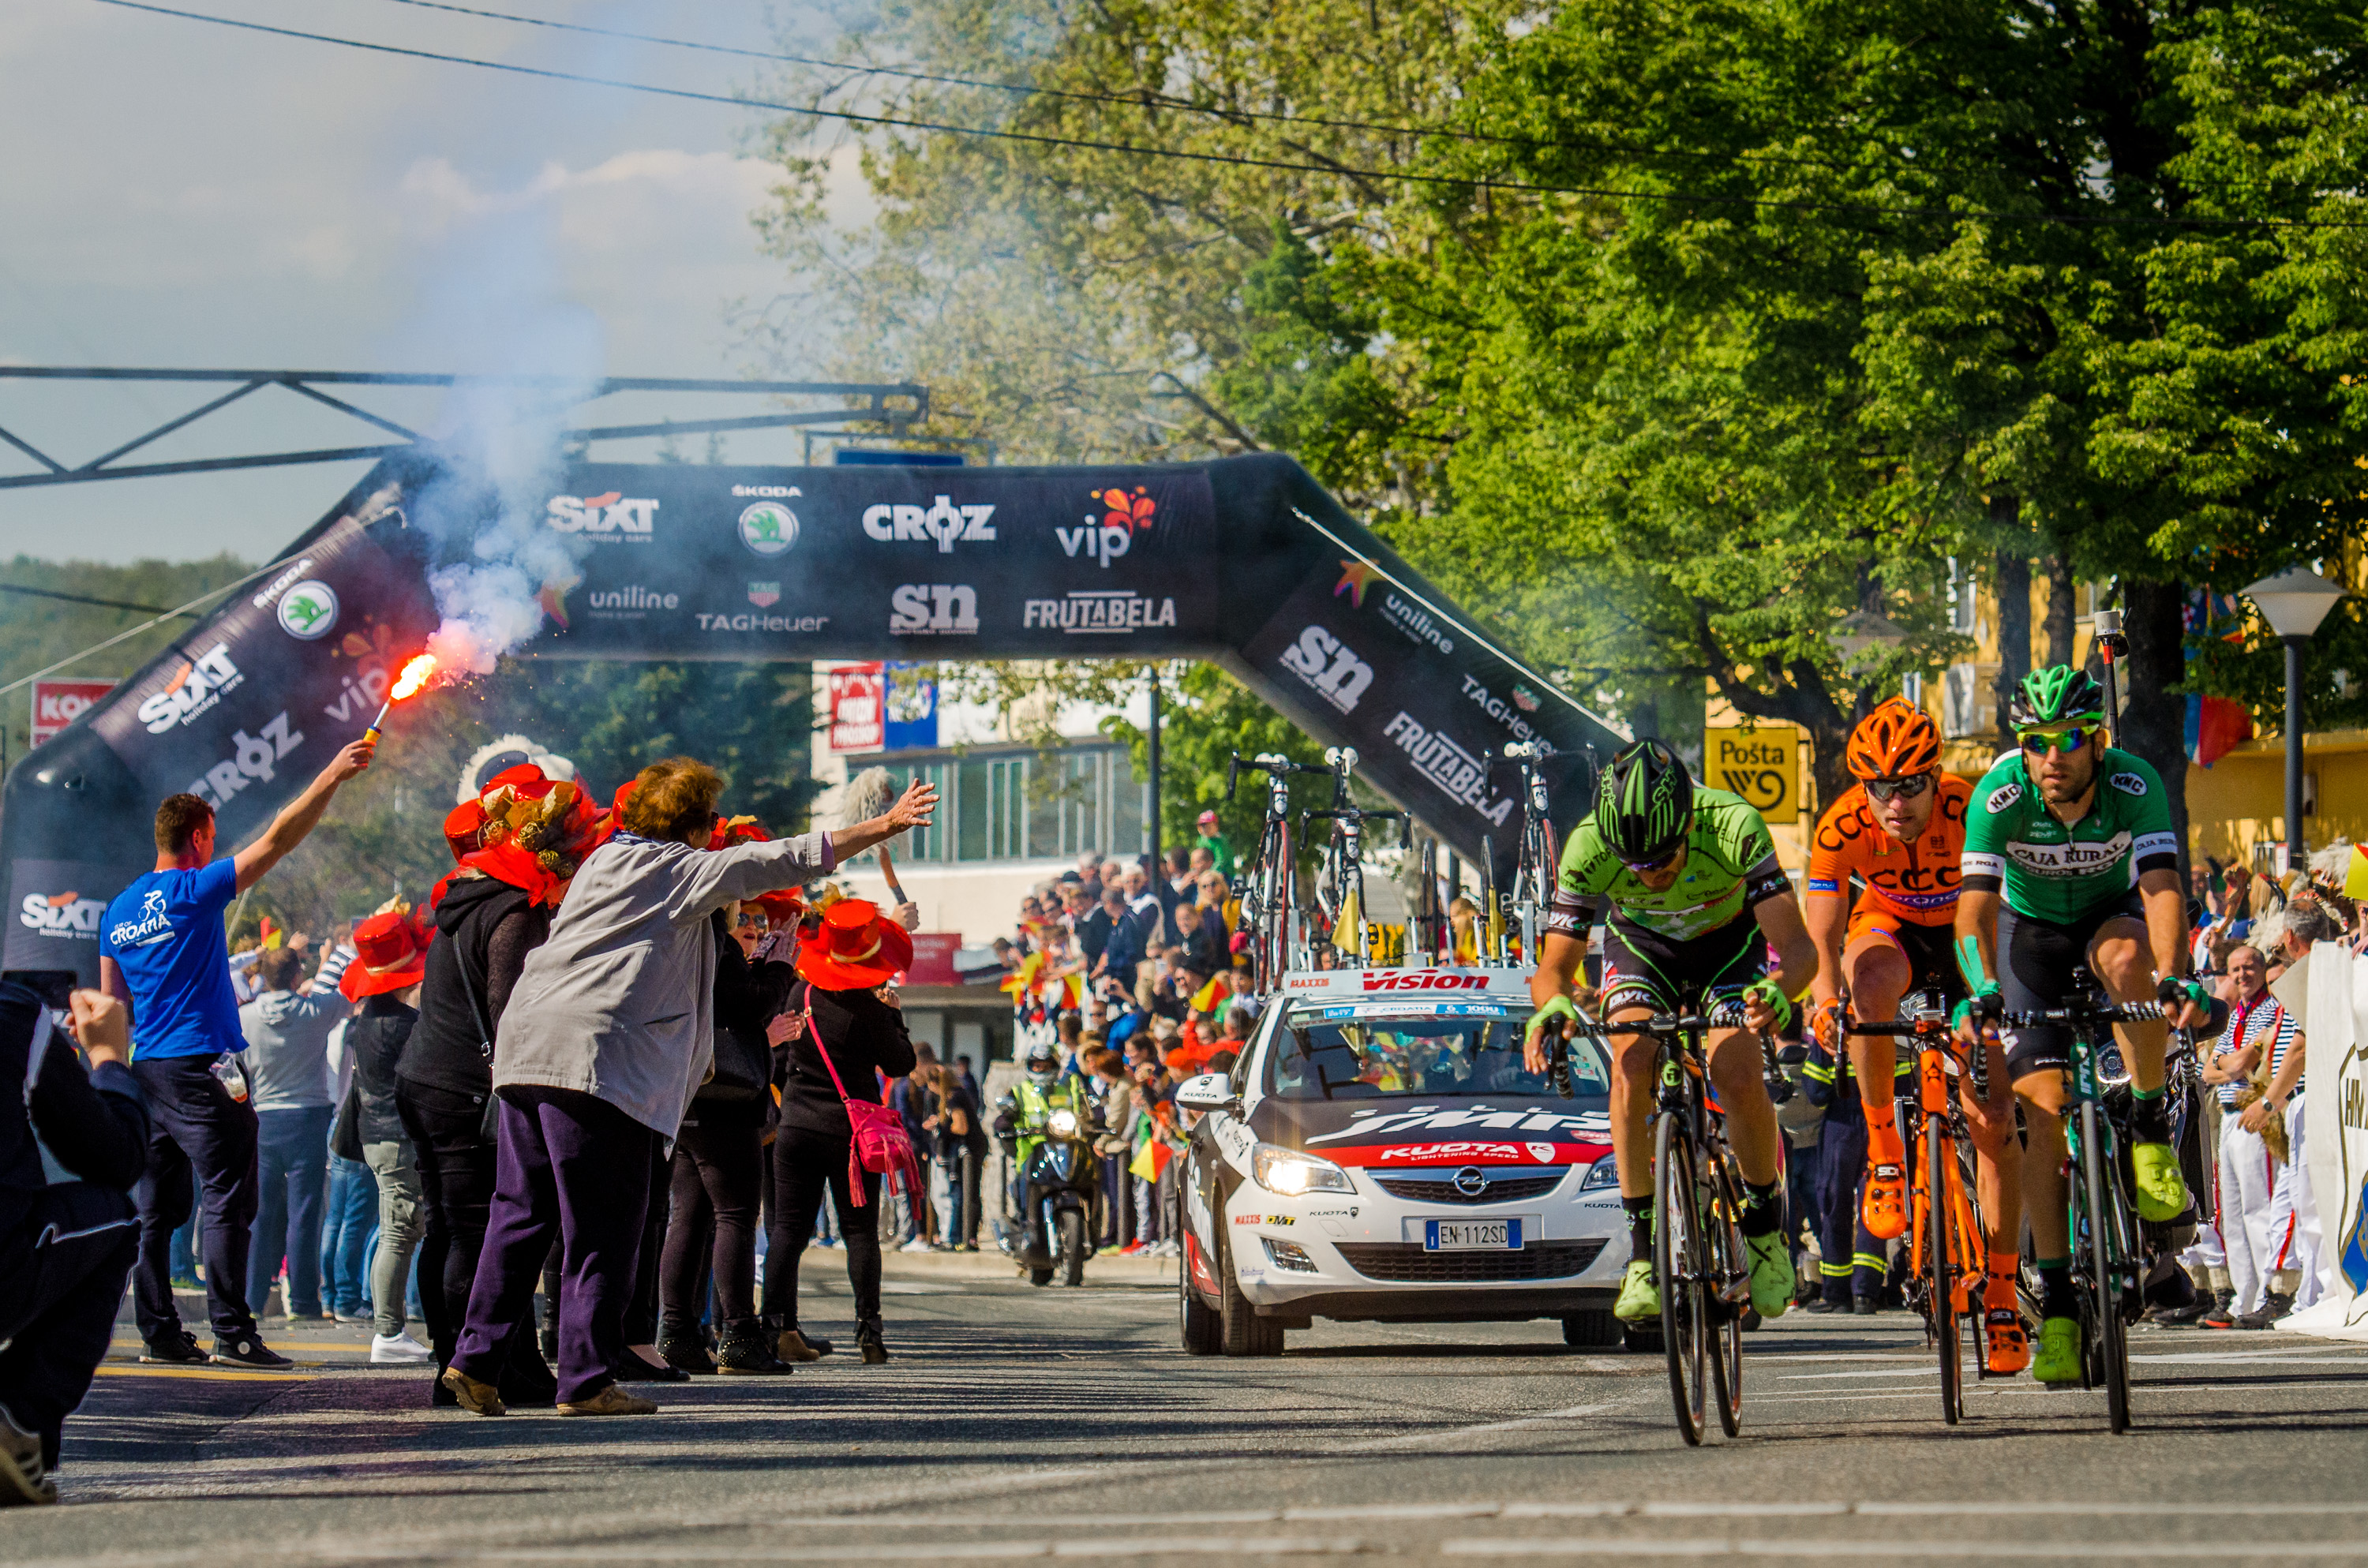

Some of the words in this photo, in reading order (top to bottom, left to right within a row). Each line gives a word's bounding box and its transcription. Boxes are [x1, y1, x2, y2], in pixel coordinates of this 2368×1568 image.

[731, 483, 804, 498] ŠKODA
[546, 491, 660, 533] SIXT
[861, 495, 997, 554] CROZ
[1055, 514, 1132, 569] vip
[589, 585, 680, 610] uniline
[889, 583, 979, 630] sn
[1022, 597, 1178, 629] FRUTABELA
[1385, 592, 1455, 655] uniline
[1281, 623, 1375, 713] sn
[137, 642, 238, 735] SIXT
[180, 690, 221, 727] holiday
[219, 672, 246, 695] cars
[324, 667, 390, 723] vip
[1720, 739, 1785, 765] Pošta
[2113, 775, 2145, 791] KMC
[1990, 784, 2020, 810] KMC
[1818, 804, 1872, 852] CCC
[2014, 848, 2062, 867] CAJA
[2065, 841, 2126, 864] RURAL
[2136, 839, 2156, 851] CAJA
[1975, 859, 1999, 869] RGA
[1868, 865, 1963, 892] CCC
[20, 890, 107, 931] SIXT
[1362, 969, 1490, 991] Vision
[1609, 990, 1651, 1009] BYK
[1381, 1142, 1519, 1160] KUOTA
[1411, 1151, 1478, 1162] LIGHTENING
[1235, 1214, 1261, 1226] MAXXIS
[1440, 1226, 1458, 1244] EN
[1463, 1226, 1508, 1244] 112SD
